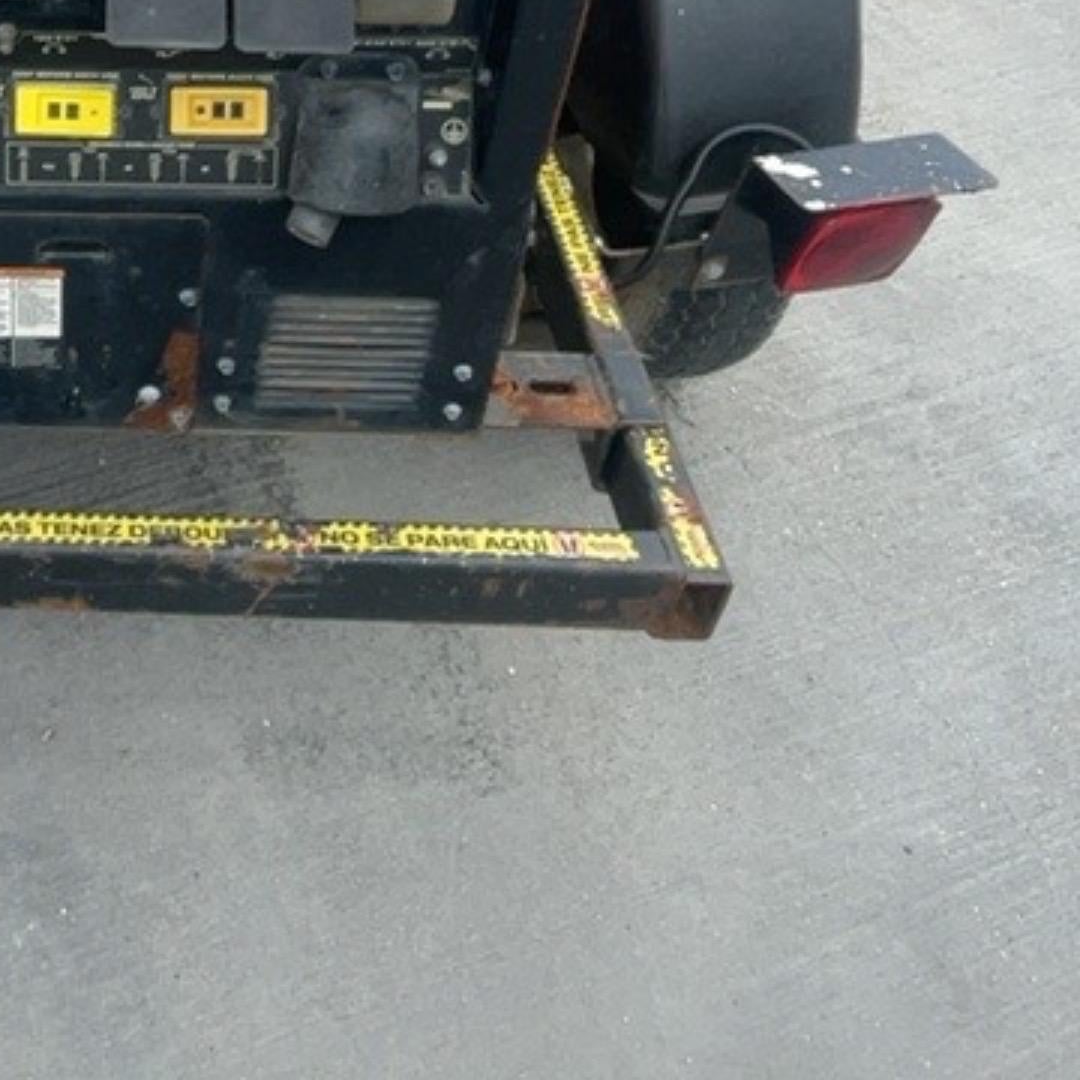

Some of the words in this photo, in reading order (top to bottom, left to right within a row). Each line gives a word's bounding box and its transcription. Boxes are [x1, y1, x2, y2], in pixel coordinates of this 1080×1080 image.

[36, 521, 121, 537] TENEZ
[320, 529, 359, 545] NO
[406, 533, 477, 550] PARE
[485, 536, 550, 554] AQUI
